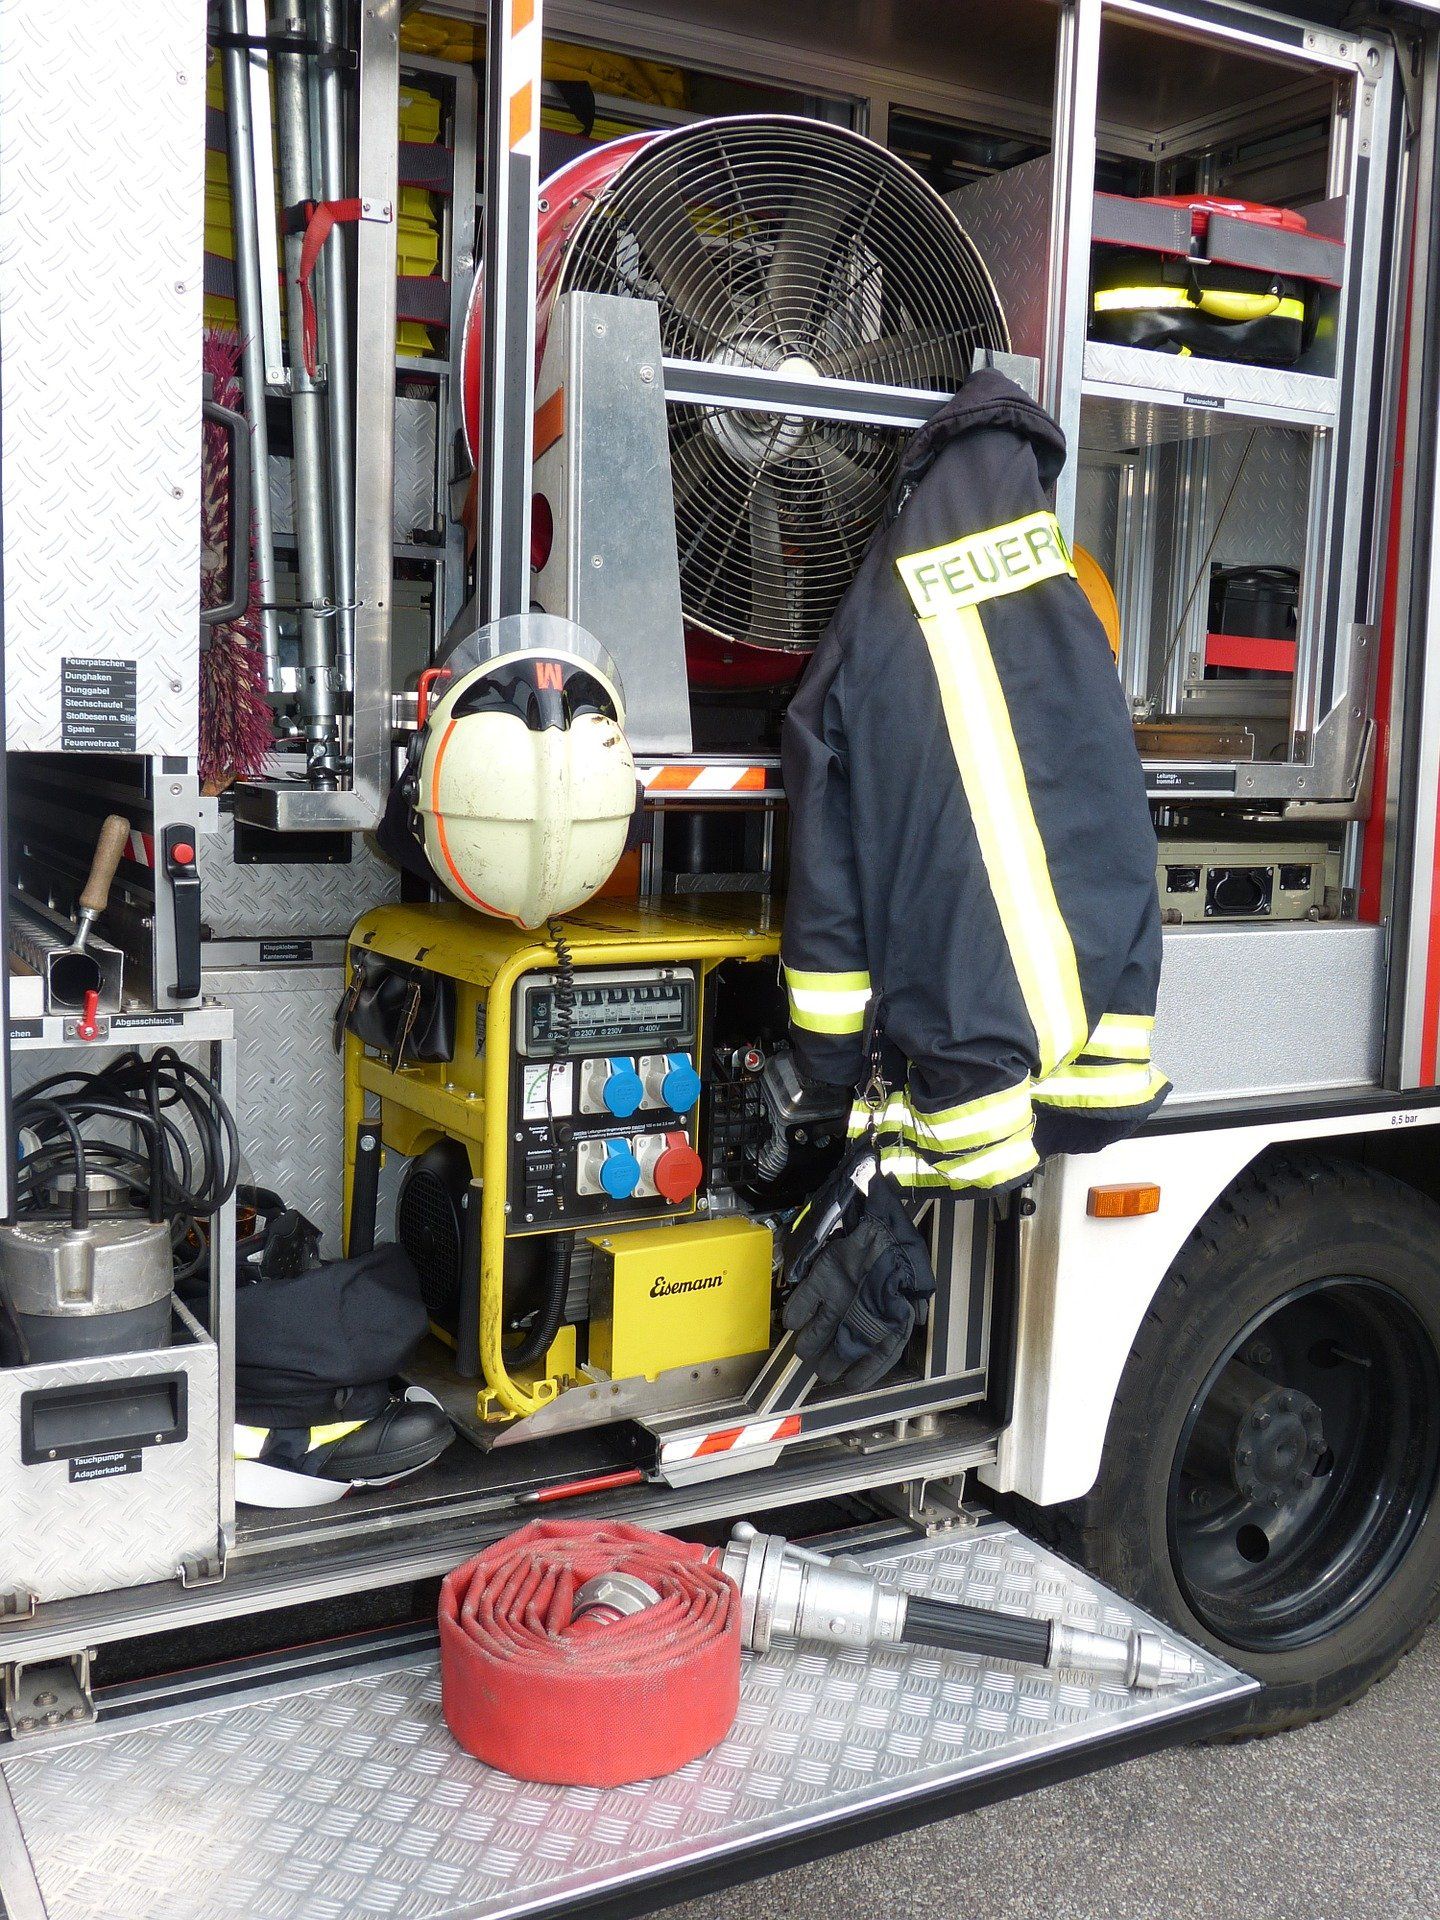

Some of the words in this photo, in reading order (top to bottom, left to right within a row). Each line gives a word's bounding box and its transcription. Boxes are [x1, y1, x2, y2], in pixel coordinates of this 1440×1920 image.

[65, 657, 125, 667] Feuerpatschen
[65, 671, 112, 681] Dunghaken
[65, 685, 110, 695] Dunggabel
[65, 698, 123, 709] Stechschaufel
[66, 711, 108, 721] Stoßbesen
[67, 725, 95, 734] Spaten
[64, 738, 120, 748] Feuerwehraxt
[115, 1016, 175, 1027] Abgasschlauch
[10, 1030, 31, 1038] chen
[1391, 1115, 1403, 1126] 8,5
[1404, 1114, 1418, 1124] bar
[650, 1275, 723, 1299] Eisemann
[74, 1452, 125, 1466] Tauchpumpe
[74, 1465, 127, 1480] Adapterkabel
